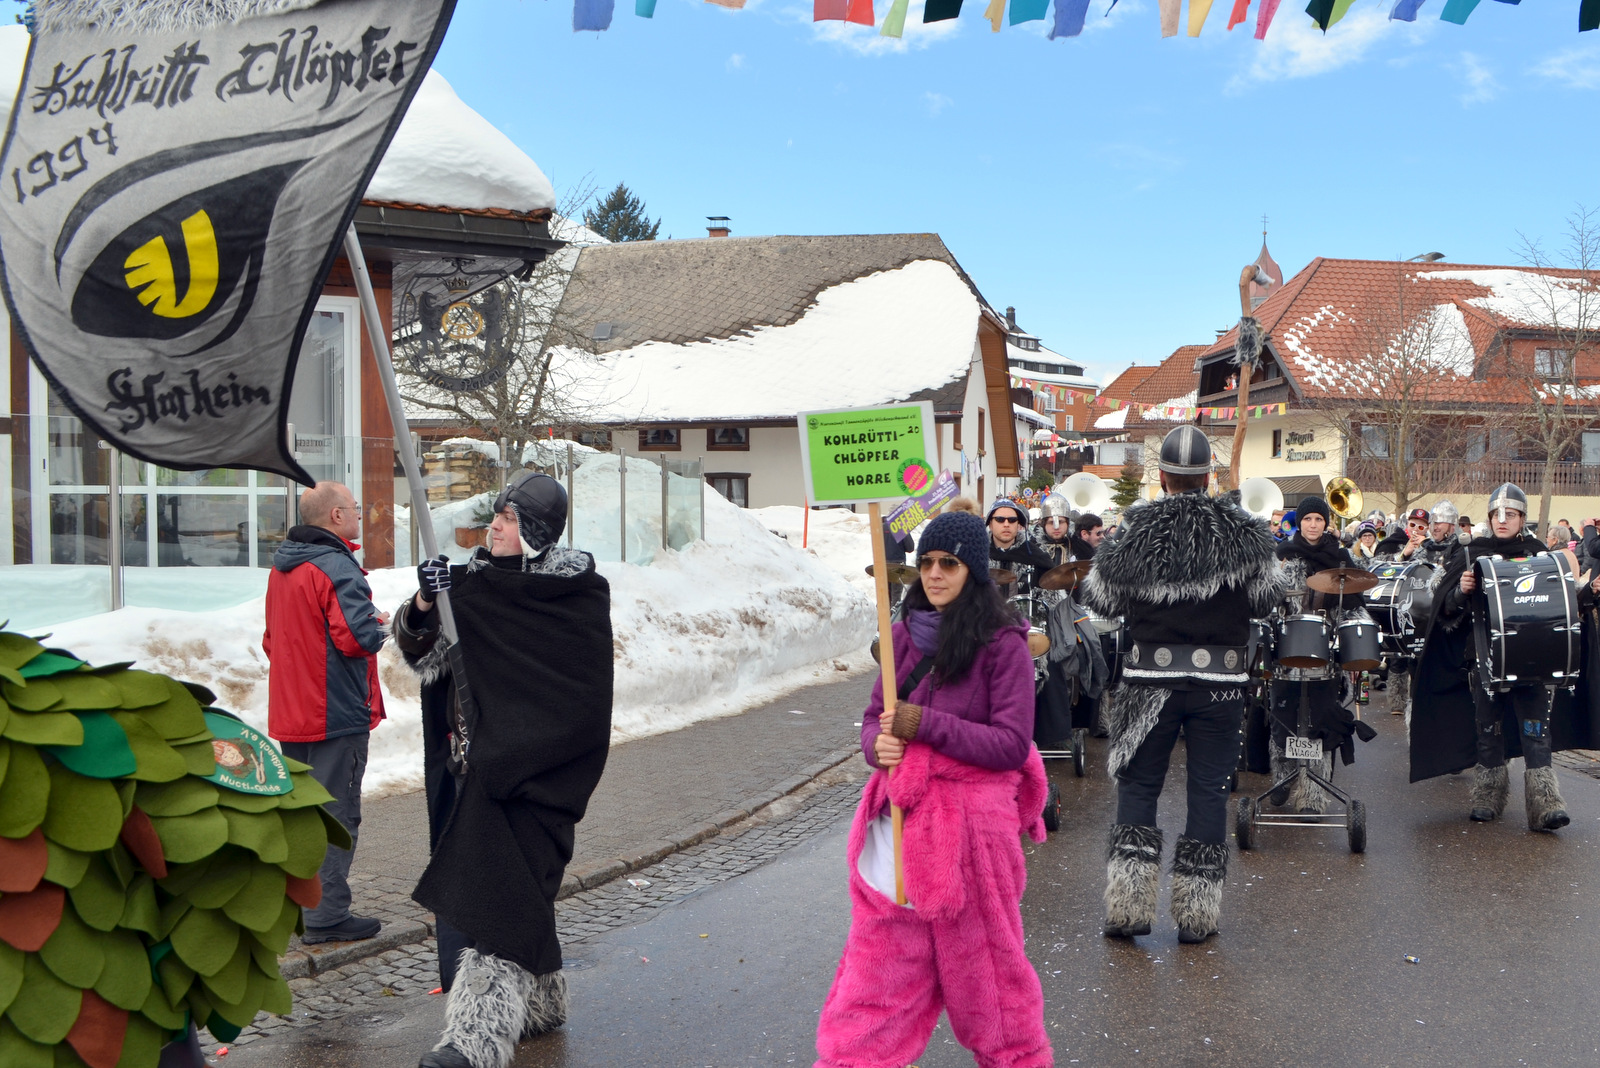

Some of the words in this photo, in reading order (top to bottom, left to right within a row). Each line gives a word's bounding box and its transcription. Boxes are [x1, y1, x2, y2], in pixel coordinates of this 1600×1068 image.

[11, 121, 119, 204] 1994
[834, 449, 899, 464] CHLÖPFER
[846, 472, 891, 486] HORRE
[889, 501, 921, 533] OFFENE
[902, 508, 928, 535] PROBE
[1513, 595, 1549, 604] CAPTAIN
[1289, 745, 1321, 758] WAGON
